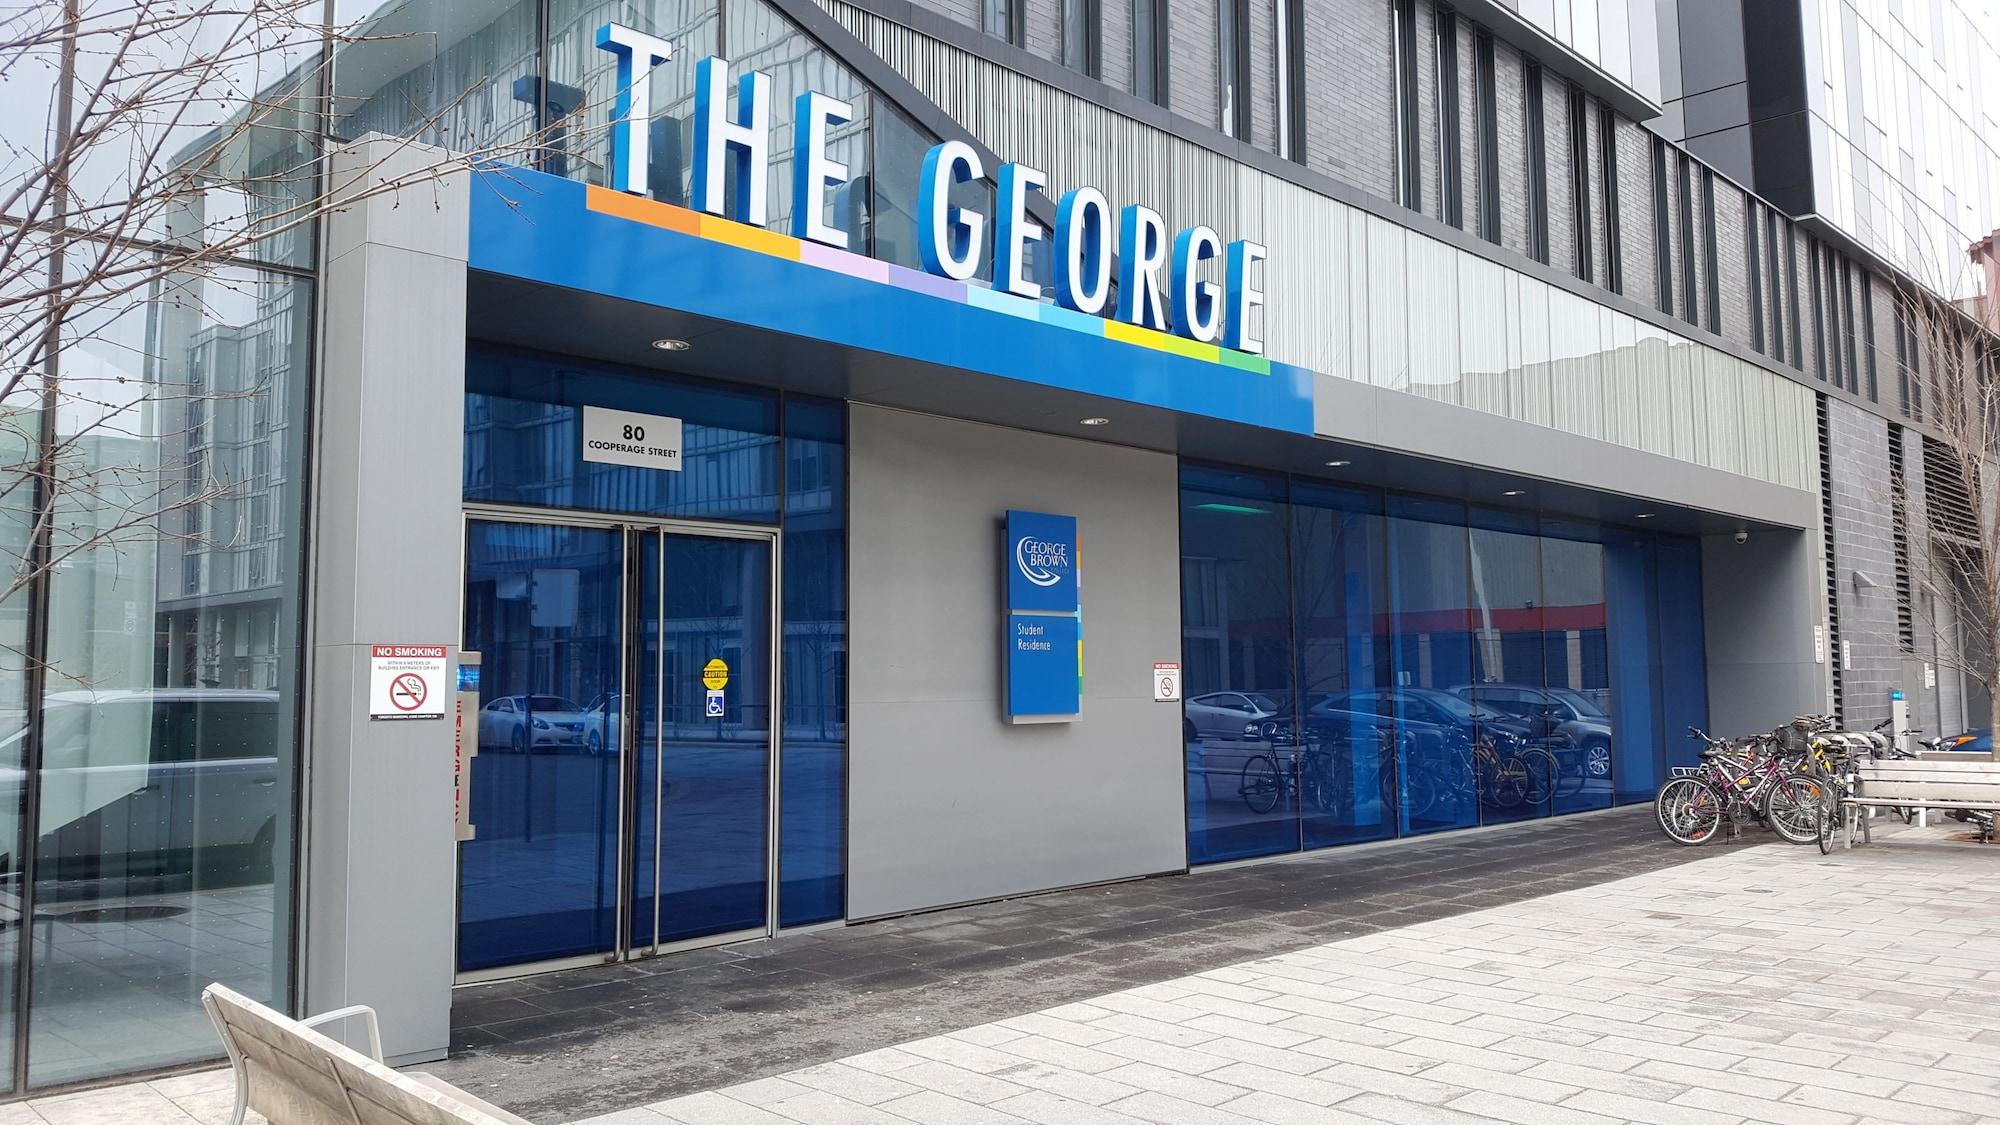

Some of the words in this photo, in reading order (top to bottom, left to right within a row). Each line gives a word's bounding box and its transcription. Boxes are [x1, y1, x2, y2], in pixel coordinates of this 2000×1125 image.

[597, 22, 853, 248] THE
[920, 140, 1267, 355] GEORGE
[623, 425, 645, 441] 80
[588, 440, 645, 454] COOPERAGE
[648, 447, 677, 458] STREET
[1025, 540, 1067, 556] GEORGE
[1030, 554, 1068, 568] BROWN
[1018, 623, 1044, 635] Student
[377, 647, 392, 656] NO
[394, 647, 442, 657] SMOKING
[1018, 639, 1051, 651] Residence
